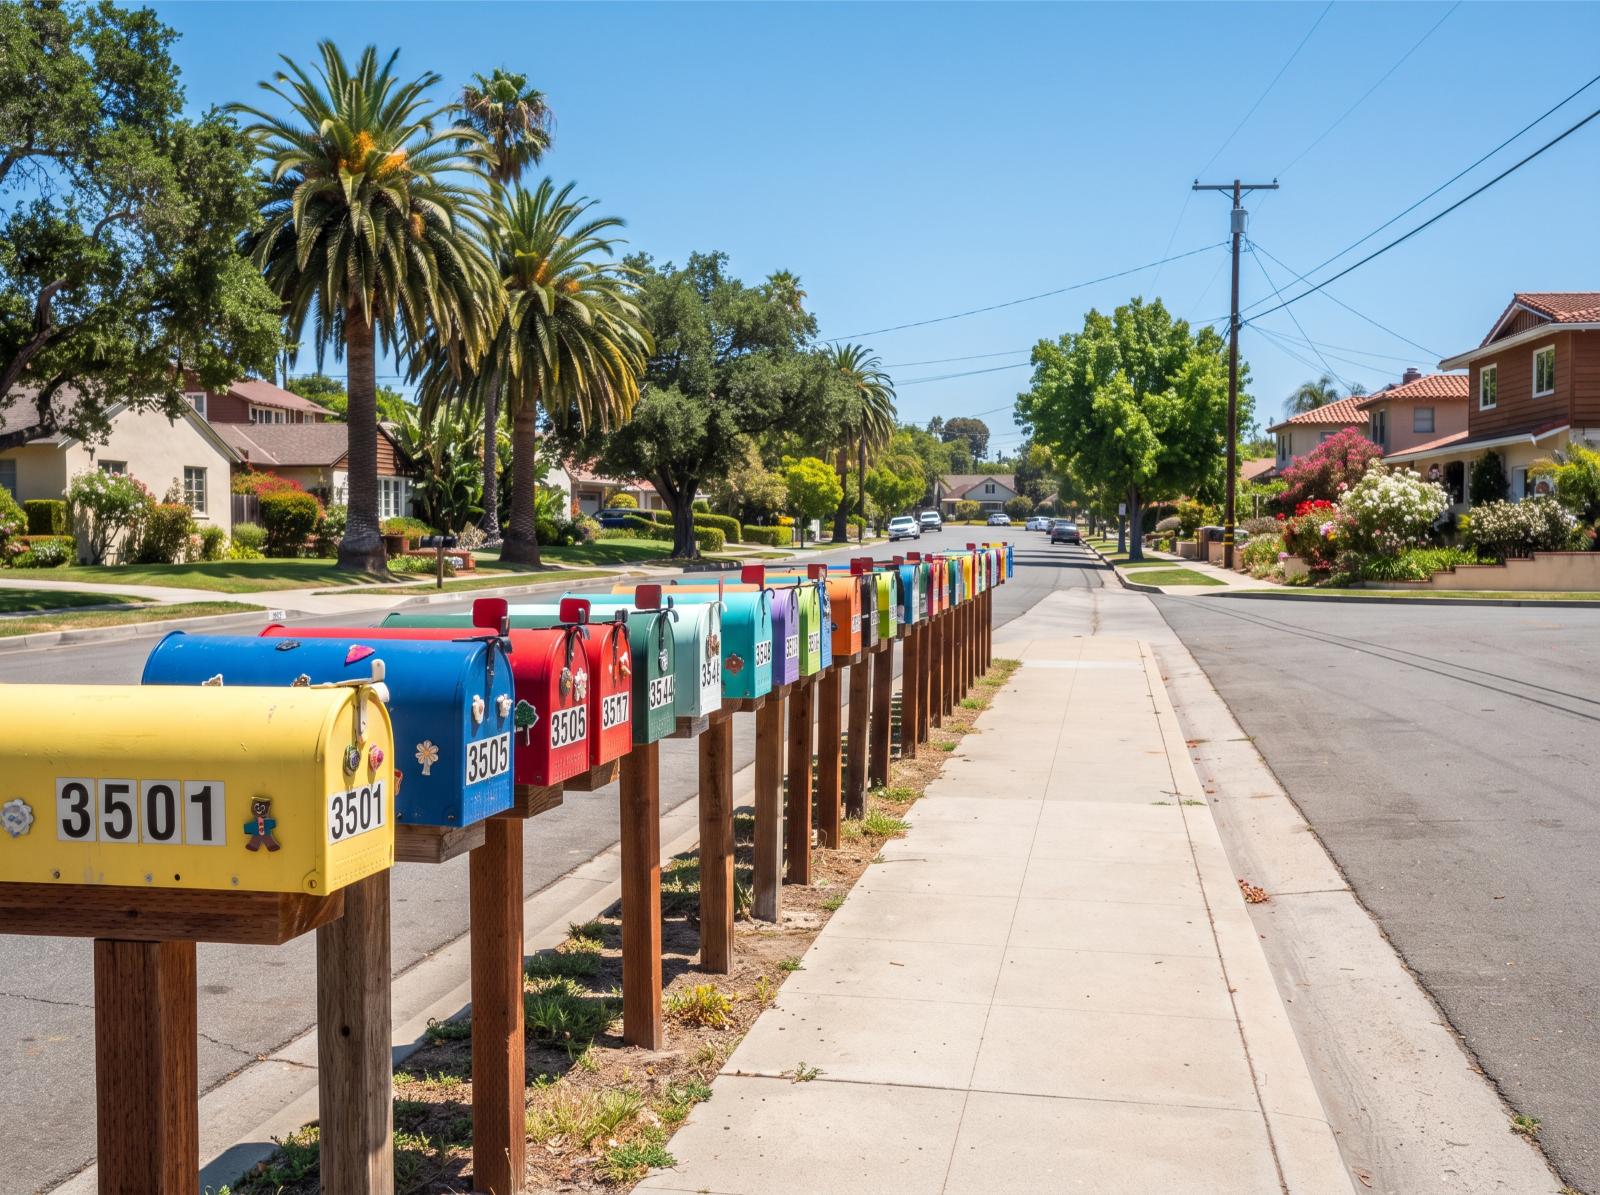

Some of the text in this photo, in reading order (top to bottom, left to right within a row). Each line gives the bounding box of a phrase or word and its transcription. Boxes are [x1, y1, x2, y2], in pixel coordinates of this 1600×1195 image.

[650, 676, 672, 707] 3544
[469, 735, 507, 782] 3505
[61, 782, 212, 840] 3501
[332, 783, 382, 840] 3501
